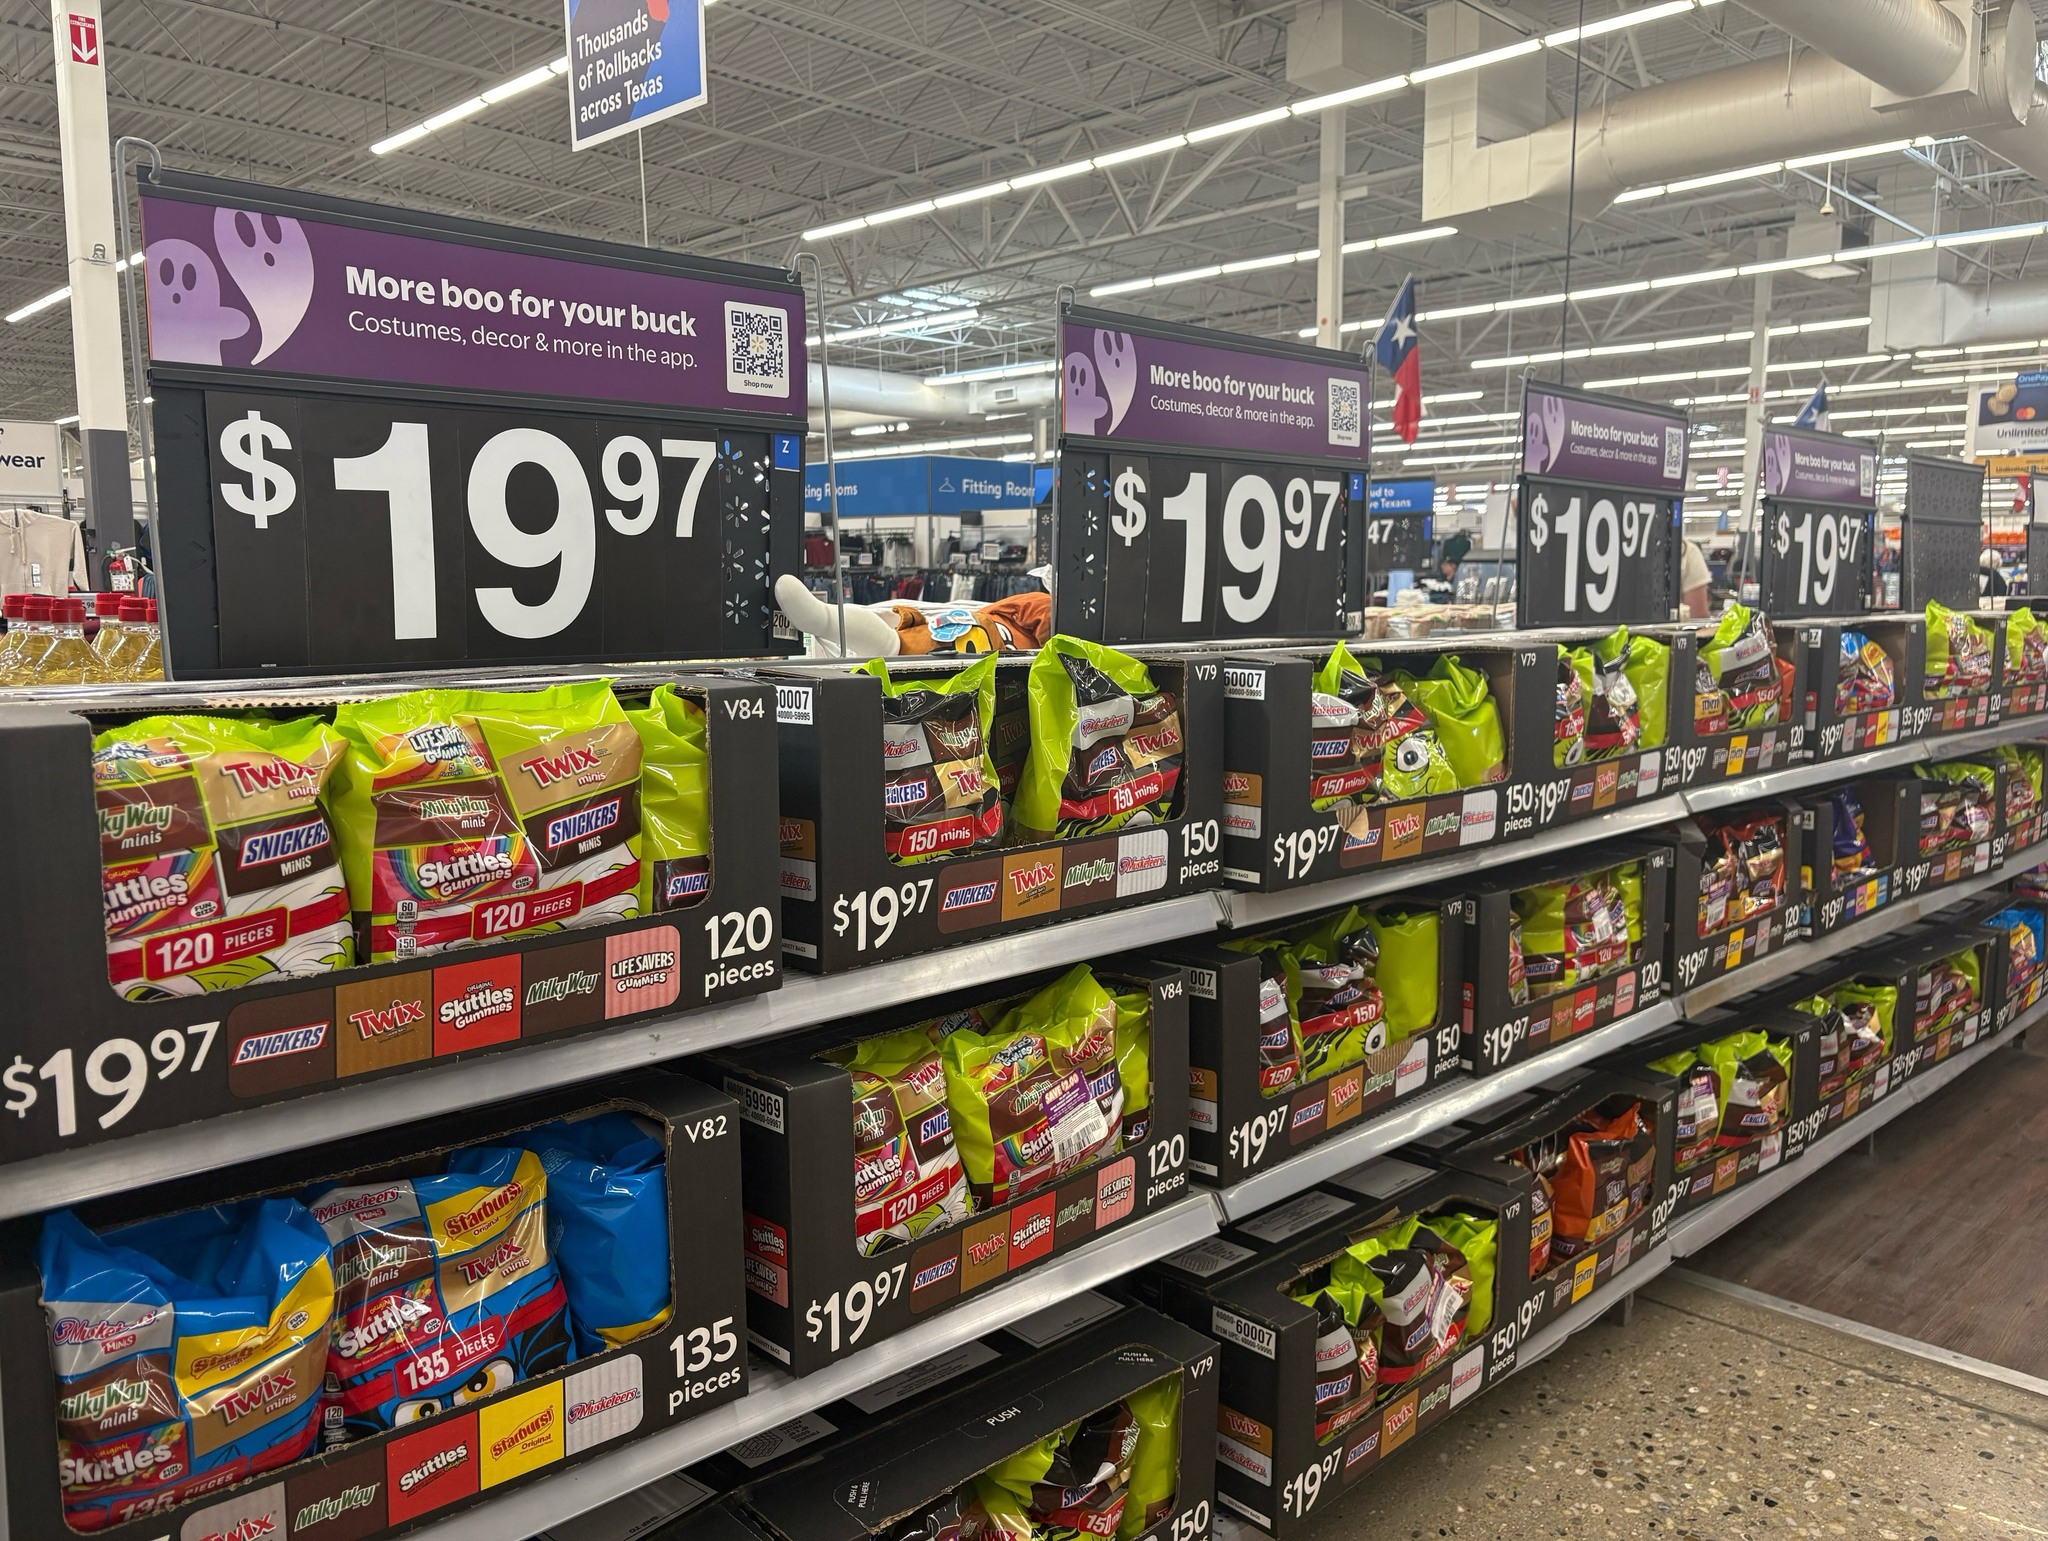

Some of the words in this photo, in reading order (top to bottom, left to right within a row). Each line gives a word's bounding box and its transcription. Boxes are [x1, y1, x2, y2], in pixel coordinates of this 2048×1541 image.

[577, 9, 648, 59] Thousands
[579, 63, 593, 91] of
[596, 39, 662, 84] Rollbacks
[580, 92, 622, 122] across
[624, 75, 663, 104] Texas
[345, 265, 436, 305] More
[441, 278, 504, 313] boo
[510, 288, 555, 320] for
[560, 300, 626, 331] your
[631, 304, 698, 337] buck
[348, 310, 468, 345] Costumes,
[471, 325, 531, 351] decor
[535, 333, 550, 352] &
[553, 339, 603, 358] more
[606, 340, 624, 360] in
[627, 344, 657, 364] the
[659, 348, 698, 371] app.
[743, 379, 760, 391] Shop
[760, 381, 774, 389] now
[1150, 365, 1191, 388] More
[1193, 371, 1221, 393] boo
[1224, 375, 1246, 396] for
[1248, 381, 1280, 401] your
[1282, 383, 1316, 405] buck
[1150, 395, 1205, 416] Costumes,
[1206, 402, 1233, 419] decor
[1236, 406, 1243, 420] &
[1244, 411, 1269, 422] more
[1269, 411, 1278, 423] in
[1280, 411, 1294, 425] the
[1296, 415, 1316, 429] app.
[782, 440, 790, 454] Z
[1571, 420, 1593, 437] More
[1593, 424, 1609, 439] boo
[1610, 426, 1622, 441] for
[1623, 431, 1641, 447] your
[1641, 432, 1658, 448] buck
[1795, 452, 1810, 465] More
[1810, 454, 1821, 467] boo
[1821, 456, 1830, 469] for
[1830, 459, 1843, 472] your
[1843, 460, 1856, 472] buck
[962, 478, 1002, 499] Fitting
[1006, 481, 1035, 496] Room
[1676, 637, 1688, 650] V79
[1195, 664, 1218, 681] V79
[1520, 652, 1537, 667] V79
[1224, 671, 1262, 688] 60007
[723, 699, 765, 720] V84
[1790, 725, 1804, 748] 120
[521, 747, 602, 789] Twix
[1665, 745, 1681, 773] 150
[222, 757, 317, 797] Twix
[1662, 773, 1680, 791] pieces
[288, 784, 320, 800] minis
[1506, 782, 1533, 814] 150
[550, 801, 619, 845] SNICKERS
[940, 827, 971, 844] minis
[1389, 813, 1420, 840] Twix
[1504, 816, 1533, 837] pieces
[244, 820, 329, 865] SNICKERS
[908, 828, 937, 853] 150
[1181, 819, 1219, 858] 150
[419, 851, 513, 890] Skittles
[1010, 861, 1056, 894] Twix
[1180, 858, 1219, 884] pieces
[944, 883, 996, 910] SNICKERS
[1448, 900, 1462, 915] V79
[481, 902, 525, 934] 120
[1785, 904, 1799, 928] 120
[224, 925, 274, 950] PIECES
[704, 906, 773, 960] 120
[1783, 927, 1799, 944] pieces
[155, 932, 214, 973] 120
[634, 951, 676, 973] SAVERS
[704, 958, 775, 997] pieces
[1641, 961, 1661, 988] 120
[1160, 980, 1184, 1001] V84
[1639, 990, 1659, 1008] pieces
[439, 986, 514, 1024] Skittles
[454, 1000, 513, 1030] Gummies
[1980, 1007, 1991, 1027] 150
[350, 1000, 425, 1040] Twix
[240, 1024, 326, 1061] SNICKERS
[1436, 1023, 1460, 1056] 150
[1434, 1055, 1459, 1079] pieces
[1892, 1058, 1903, 1077] 150
[1044, 1087, 1062, 1107] SAVE
[1332, 1078, 1360, 1107] Twix
[1293, 1101, 1325, 1128] SNICKERS
[684, 1115, 728, 1143] V82
[1787, 1123, 1803, 1146] 150
[1147, 1134, 1185, 1178] 120
[1147, 1172, 1185, 1206] pieces
[446, 1181, 523, 1240] Starburst
[1505, 1203, 1521, 1221] V79
[1651, 1202, 1667, 1230] 120
[1012, 1215, 1051, 1247] Skittles
[968, 1231, 1006, 1265] Twix
[914, 1258, 956, 1288] SNICKERS
[669, 1316, 738, 1379] 135
[1492, 1321, 1516, 1360] 150
[1190, 1356, 1214, 1380] V79
[1489, 1352, 1516, 1381] pieces
[216, 1372, 296, 1424] Twix
[668, 1365, 742, 1416] pieces
[986, 1406, 1022, 1427] PUSH
[1386, 1402, 1414, 1435] Twix
[490, 1409, 554, 1460] Starburst
[520, 1434, 552, 1451] Original
[399, 1443, 469, 1492] Skittles
[848, 1488, 857, 1503] PUSH
[1171, 1500, 1209, 1541] 150
